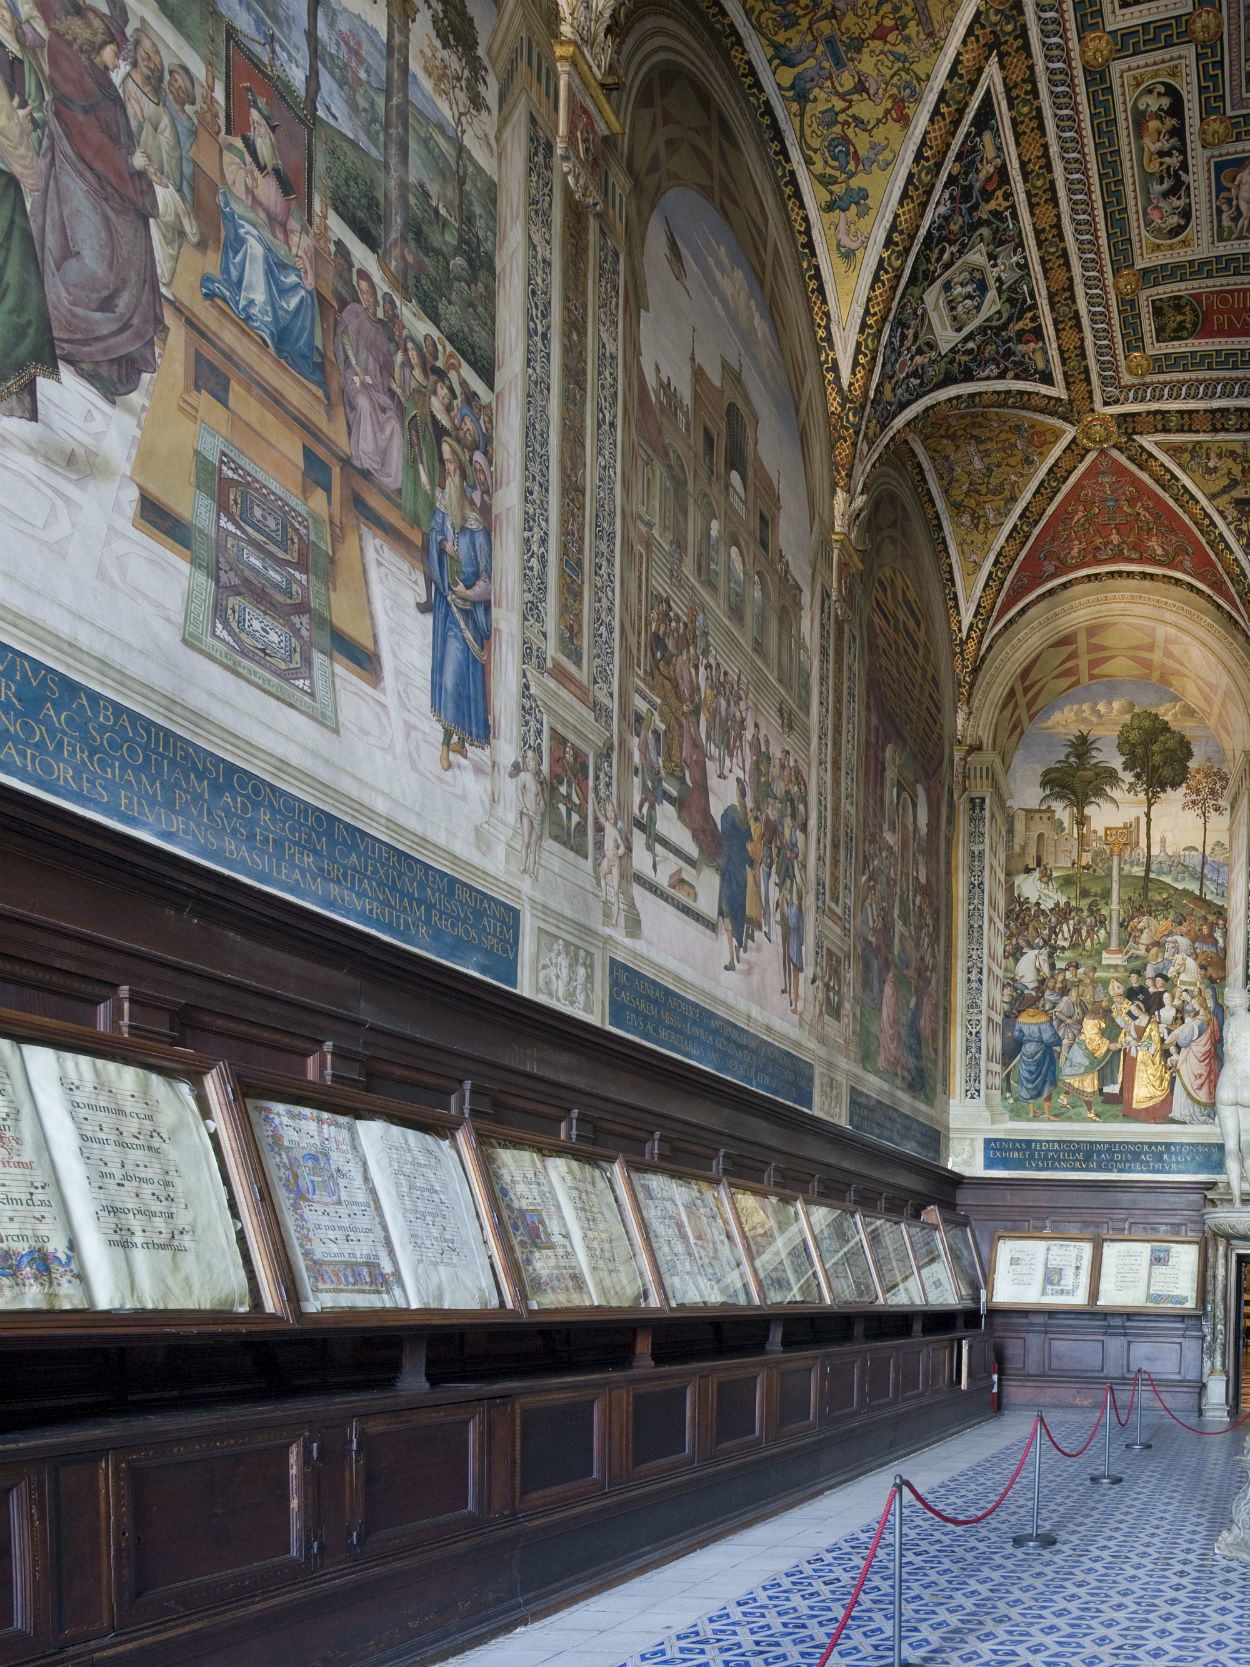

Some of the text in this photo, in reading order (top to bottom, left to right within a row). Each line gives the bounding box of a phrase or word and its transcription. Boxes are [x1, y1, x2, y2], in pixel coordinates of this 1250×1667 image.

[0, 741, 108, 802] ATORES
[119, 789, 217, 850] ELVDENS
[224, 836, 322, 895] BASILEAM
[40, 702, 80, 736] AC
[88, 722, 209, 799] SCOTIAM
[219, 792, 251, 818] AD
[260, 807, 327, 855] REGEM
[426, 888, 474, 923] MISSVS
[233, 773, 327, 832] CONCILIO
[455, 884, 513, 925] BRITANNI
[174, 789, 246, 840] PVLSVS
[256, 827, 278, 852] ET
[285, 841, 320, 873] PER
[324, 859, 425, 920] BRITANNIAM
[432, 910, 479, 944] REGIOS
[481, 934, 515, 960] SPECV
[613, 966, 630, 986] HIC
[634, 977, 665, 1003] AENEAS
[613, 986, 658, 1018] CAESAREM
[626, 1011, 644, 1031] EIVS
[990, 1141, 1026, 1149] AENEAS
[1111, 1144, 1165, 1152] LEONORAM
[990, 1150, 1030, 1159] EXHIBET
[1035, 1151, 1045, 1159] ET
[1047, 1151, 1085, 1160] PVELLAE
[1140, 1153, 1153, 1161] AC
[1026, 1160, 1097, 1169] LVSITANORVM
